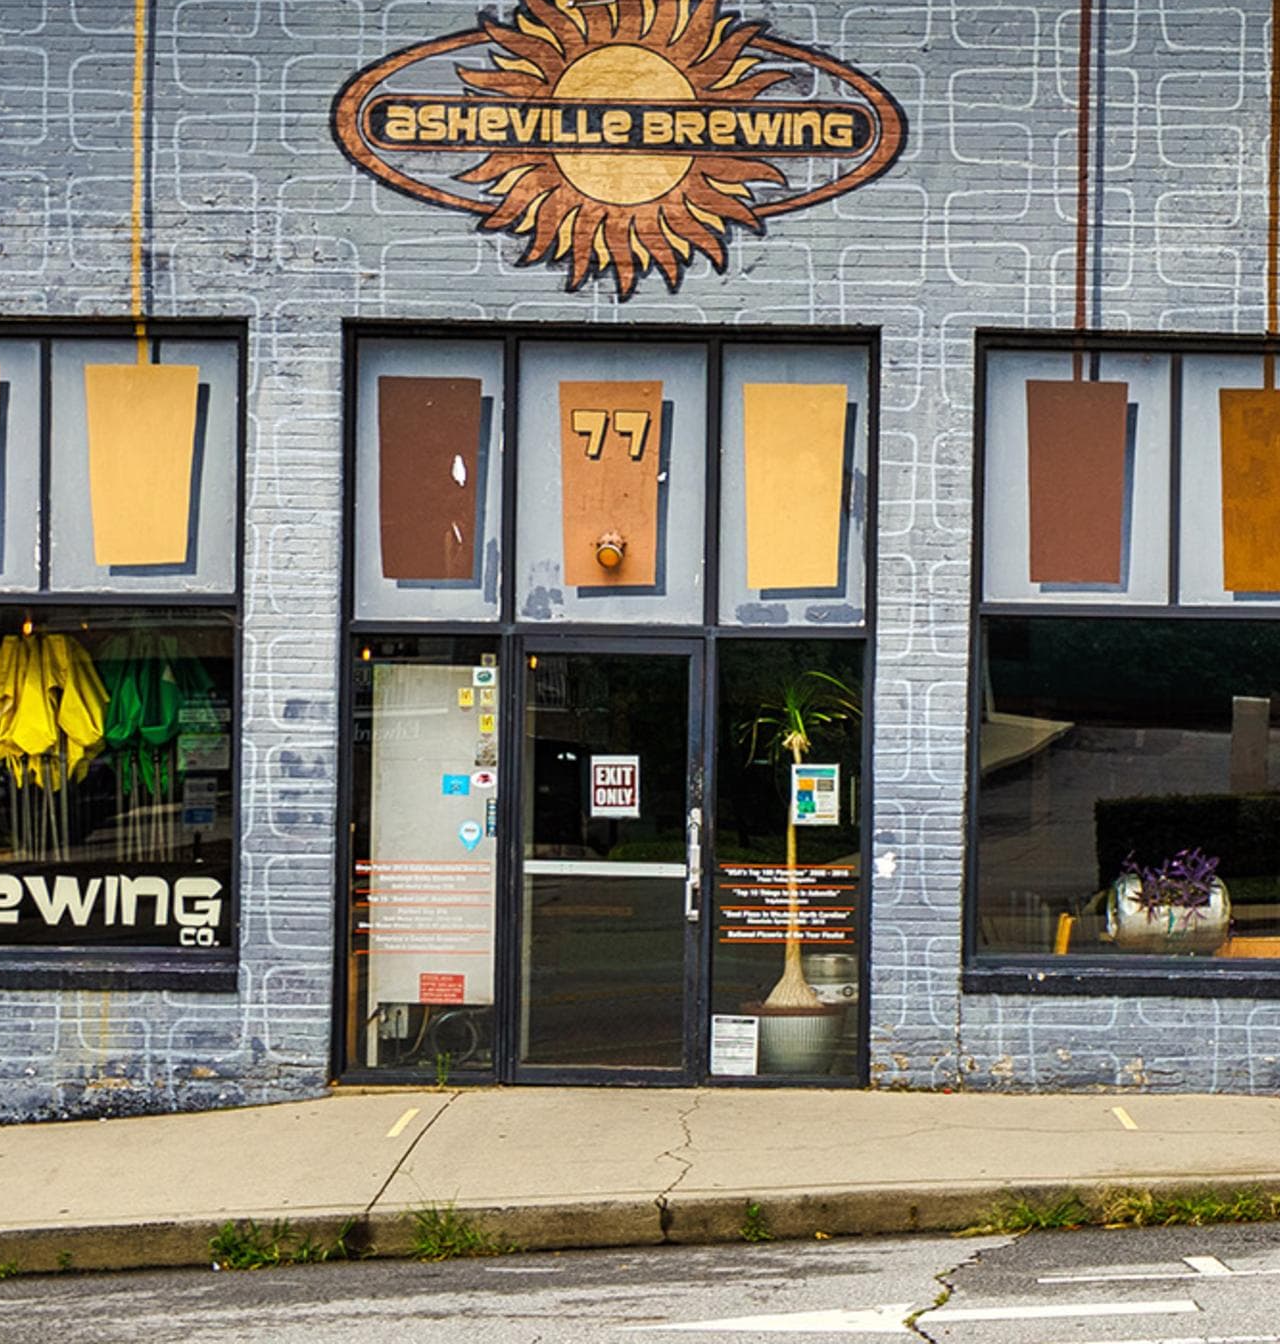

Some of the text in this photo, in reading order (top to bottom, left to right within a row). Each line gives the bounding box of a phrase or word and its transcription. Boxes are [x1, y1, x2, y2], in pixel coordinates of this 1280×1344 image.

[571, 409, 651, 461] 77
[596, 767, 634, 786] EXIT
[596, 788, 634, 805] ONLY
